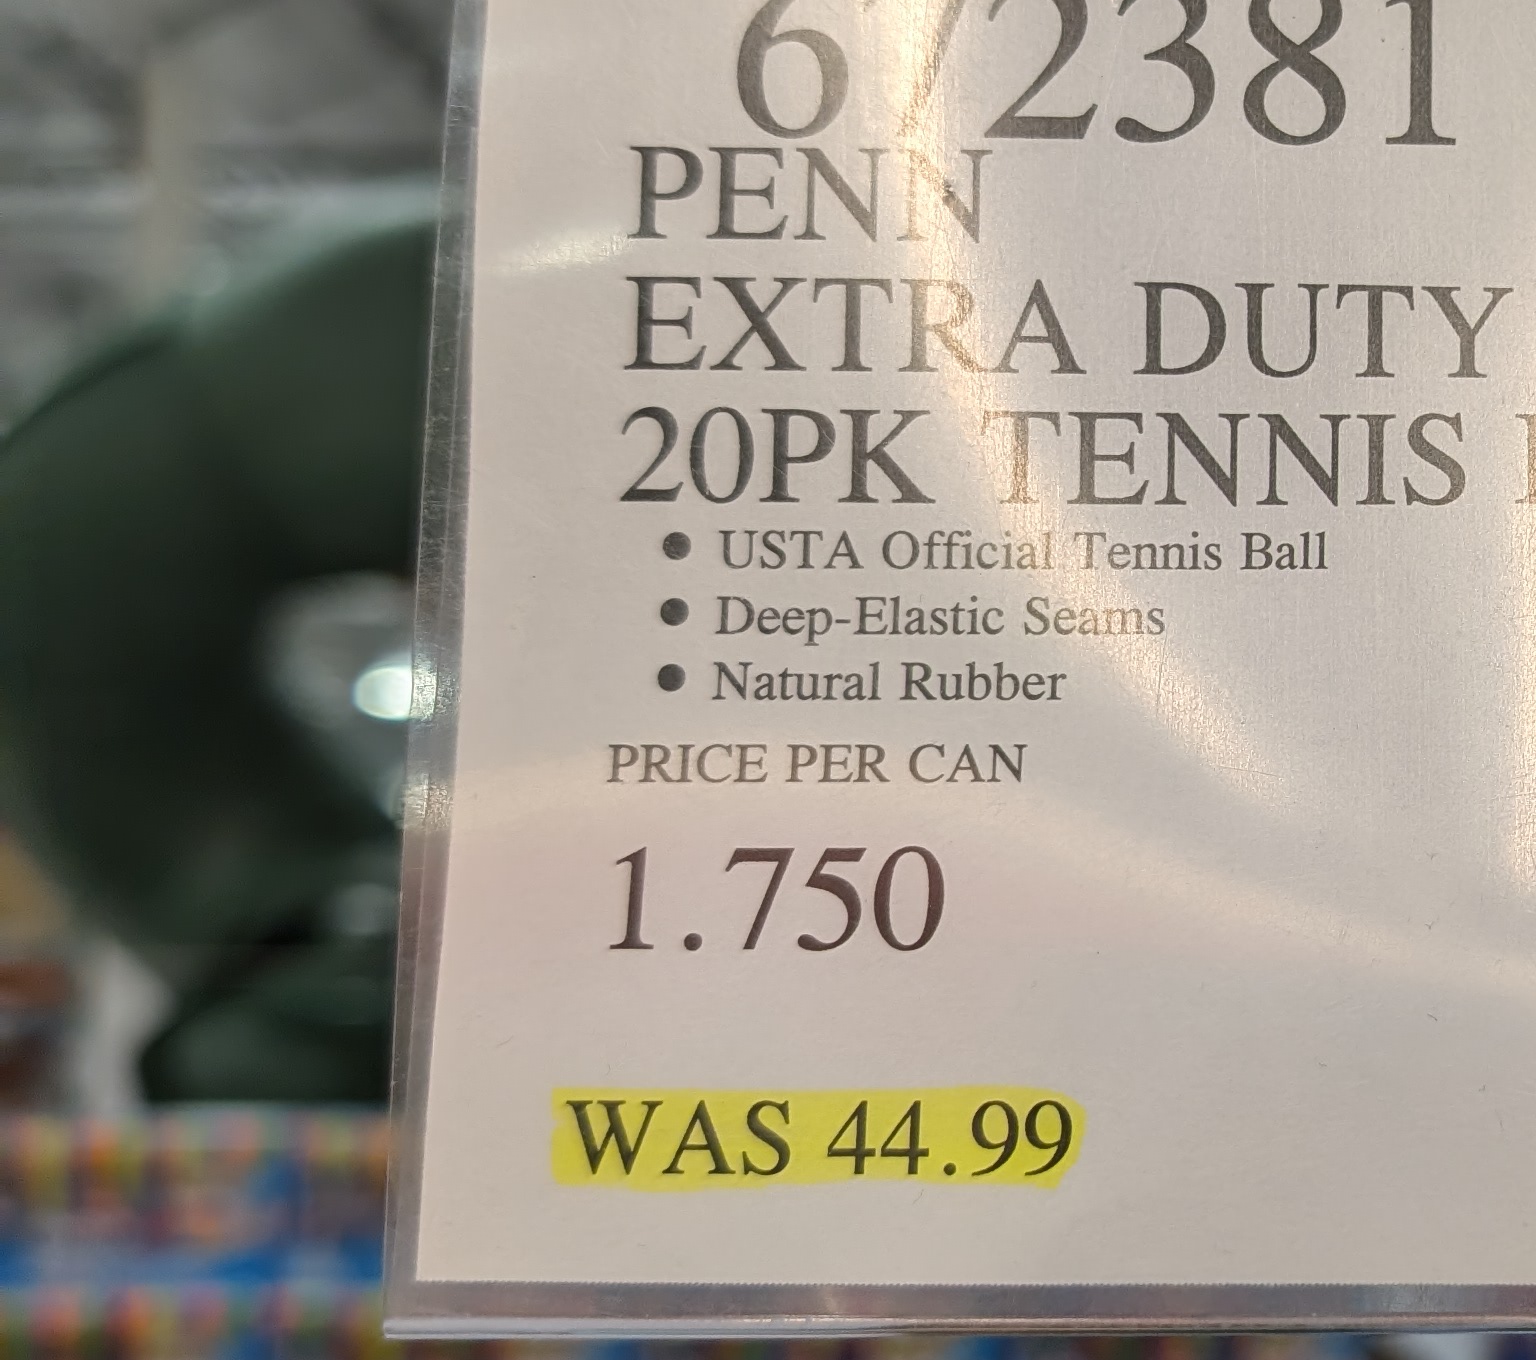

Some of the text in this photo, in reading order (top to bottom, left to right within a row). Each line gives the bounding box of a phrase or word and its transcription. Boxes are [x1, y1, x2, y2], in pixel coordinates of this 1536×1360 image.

[627, 145, 993, 244] PENN
[623, 276, 1514, 378] EXTRA DUTY
[619, 406, 936, 504] 20PK
[981, 409, 1466, 507] TENNIS
[717, 526, 1328, 573] USTA Official Tennis Ball
[714, 595, 1165, 646] Deep-Elastic Seams
[711, 661, 1067, 701] Natural Rubber
[606, 744, 1028, 783] PRICE PER CAN
[609, 846, 944, 951] 1.750
[564, 1100, 1072, 1177] WAS 44.99
